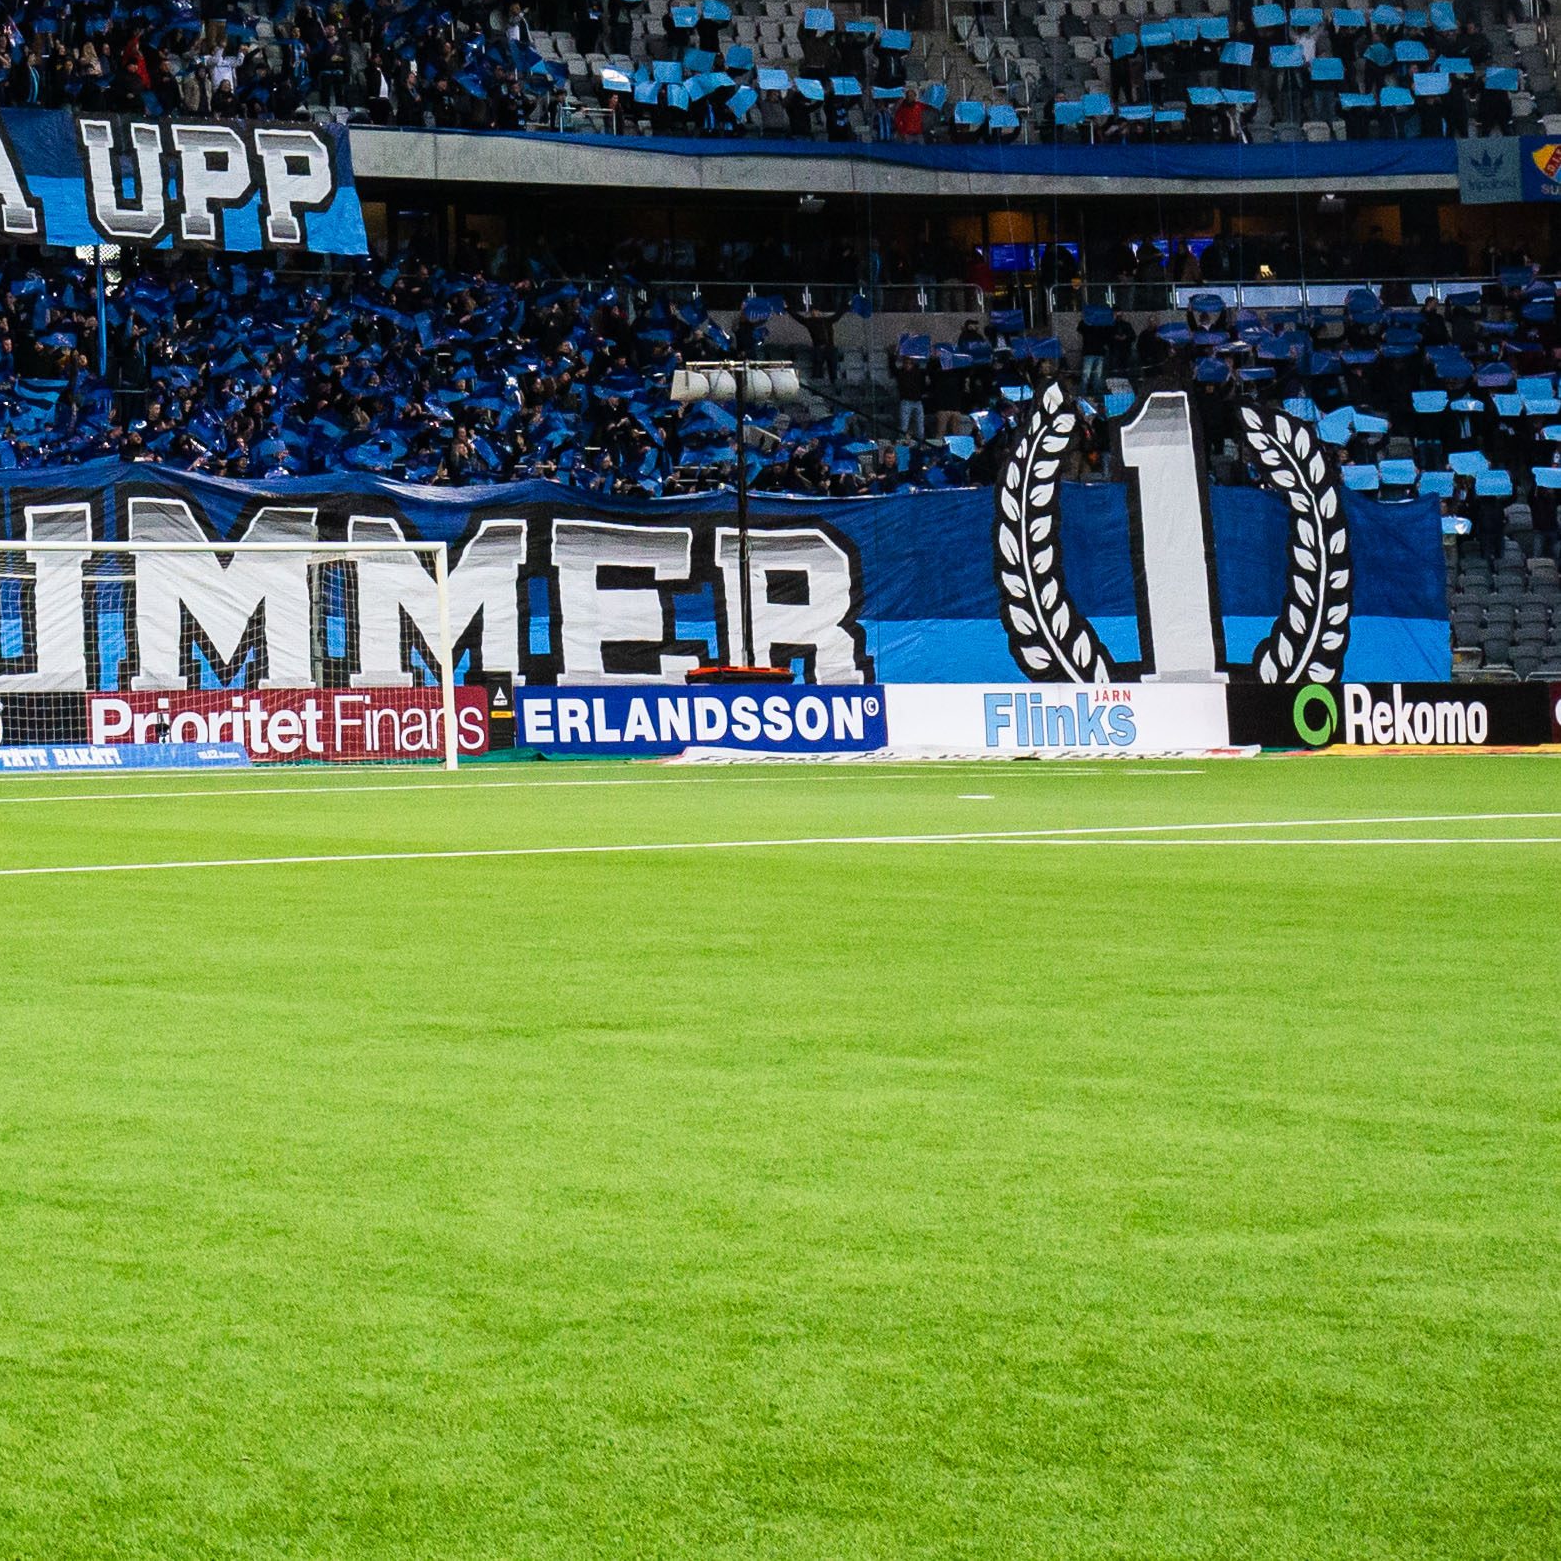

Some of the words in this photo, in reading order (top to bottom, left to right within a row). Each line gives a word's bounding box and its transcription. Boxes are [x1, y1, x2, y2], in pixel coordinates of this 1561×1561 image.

[79, 115, 335, 246] UPP
[1120, 390, 1229, 683] 1
[91, 695, 324, 754] Prioritet
[983, 692, 1137, 747] Flinks
[1094, 688, 1133, 703] JÄRN
[1343, 682, 1488, 745] Rekomo
